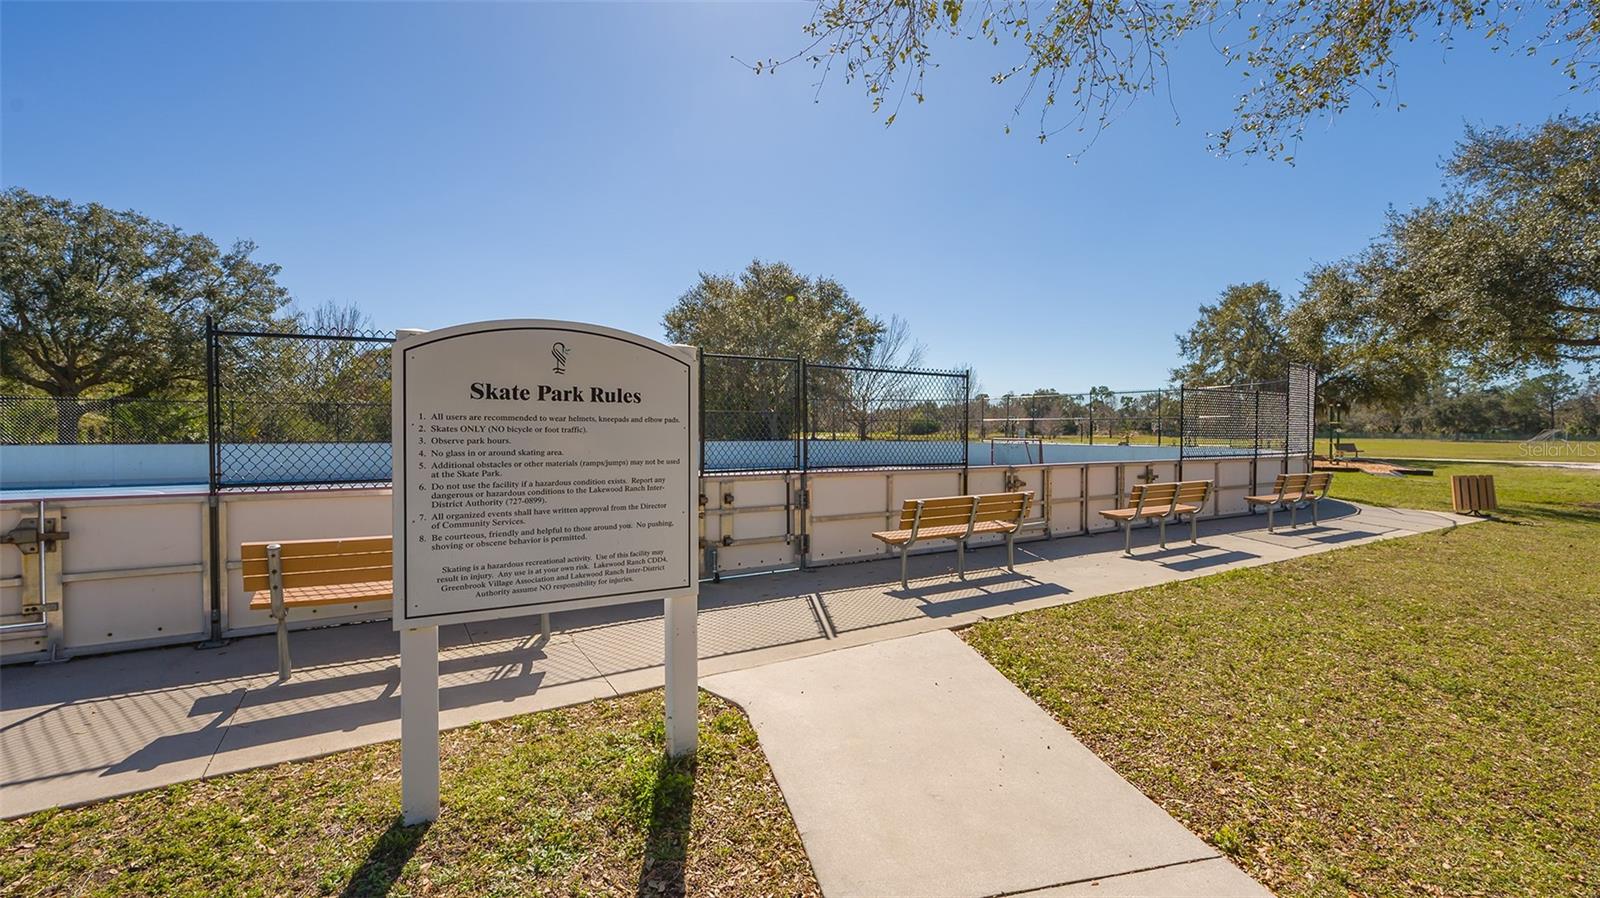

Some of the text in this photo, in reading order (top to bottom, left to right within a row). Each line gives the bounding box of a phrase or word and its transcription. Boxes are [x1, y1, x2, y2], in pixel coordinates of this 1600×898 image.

[470, 383, 642, 404] Skate Park Rules
[430, 413, 444, 421] All
[598, 416, 630, 424] kneepads
[418, 425, 426, 433] 2.
[430, 425, 459, 433] Skates
[460, 425, 487, 433] ONLY
[487, 425, 506, 434] (NO
[507, 426, 533, 434] bicycle
[418, 437, 512, 446] 3. Observe park hours.
[431, 449, 444, 457] No
[445, 450, 466, 459] glass
[488, 448, 517, 457] around
[518, 449, 546, 457] skating
[418, 462, 427, 470] 5.
[431, 461, 475, 469] Additional
[476, 460, 513, 469] obstacles
[524, 460, 544, 468] other
[431, 470, 440, 478] at
[457, 470, 480, 478] Skate
[419, 483, 427, 491] 6.
[431, 483, 445, 491] Do
[446, 482, 462, 490] not
[477, 481, 491, 489] the
[492, 480, 520, 489] facility
[521, 480, 528, 488] if
[631, 477, 653, 485] Report
[431, 492, 474, 501] dangerous
[486, 489, 526, 498] hazardous
[527, 488, 566, 496] conditions
[589, 485, 623, 494] Lakewood
[625, 484, 646, 492] Ranch
[432, 500, 463, 509] District
[465, 499, 504, 507] Authority
[431, 513, 445, 521] All
[445, 511, 486, 522] organized
[579, 505, 609, 514] approval
[442, 519, 491, 529] Community
[419, 535, 427, 543] 8.
[444, 533, 487, 541] courteous,
[488, 529, 520, 538] friendly
[521, 528, 535, 536] and
[536, 527, 563, 536] helpful
[573, 525, 592, 533] those
[593, 523, 618, 531] around
[432, 542, 464, 551] shoving
[476, 540, 507, 548] obscene
[509, 537, 542, 545] behavior
[442, 565, 472, 574] Skating
[487, 561, 524, 570] hazardous
[525, 557, 566, 567] recreational
[567, 555, 594, 563] activity.
[609, 552, 617, 560] of
[437, 575, 459, 583] result
[470, 573, 494, 581] injury.
[497, 571, 513, 579] Any
[534, 567, 542, 575] at
[543, 567, 560, 575] your
[593, 560, 626, 569] Lakewood
[626, 558, 646, 566] Ranch
[441, 581, 487, 592] Greenbrook
[488, 580, 515, 588] Village
[515, 576, 555, 585] Association
[556, 573, 569, 581] and
[570, 570, 604, 580] Lakewood
[626, 565, 665, 574] Inter-District
[475, 588, 511, 598] Authority
[512, 586, 538, 594] assume
[553, 580, 597, 590] responsibility
